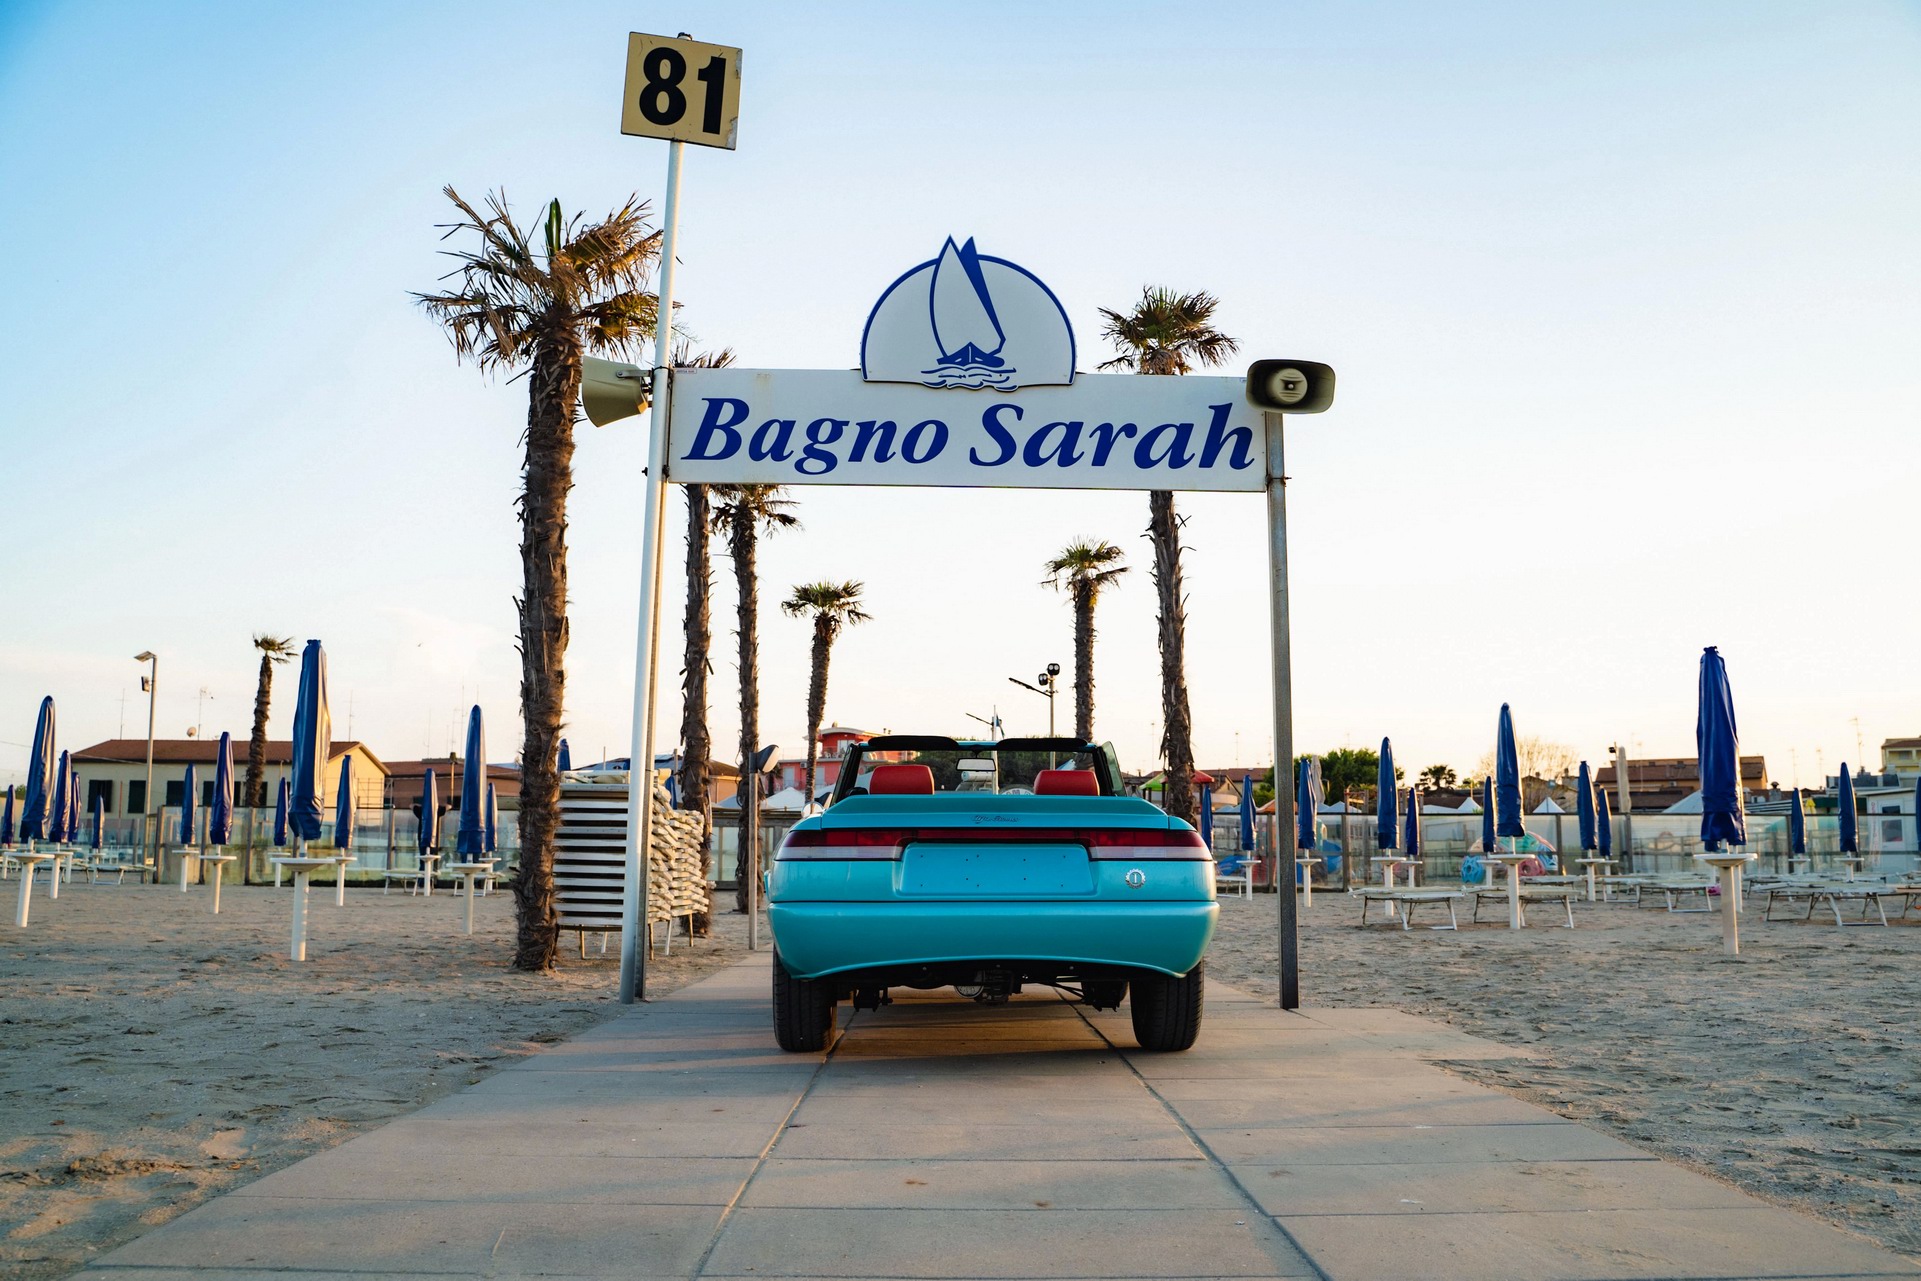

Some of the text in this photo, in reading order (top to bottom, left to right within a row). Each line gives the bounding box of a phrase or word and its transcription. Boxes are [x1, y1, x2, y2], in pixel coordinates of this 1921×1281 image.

[639, 46, 727, 135] 81
[681, 397, 1255, 475] Bagno Sarah
